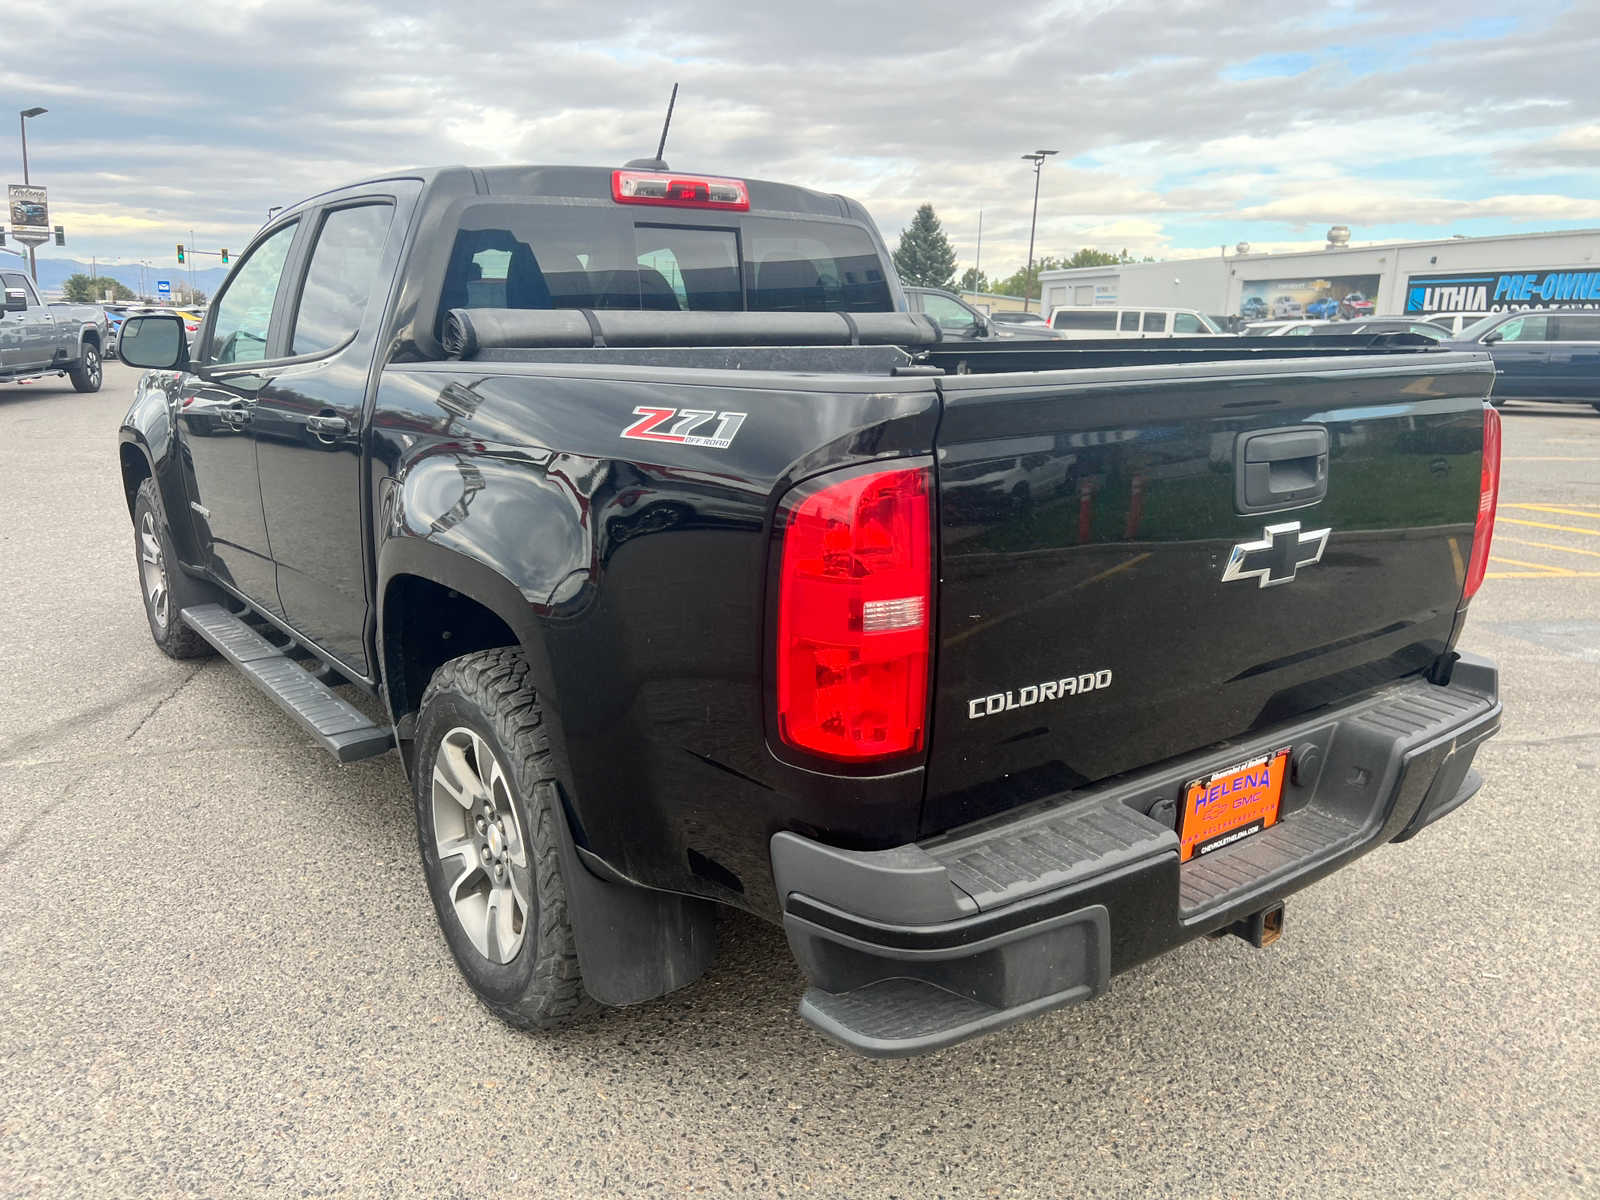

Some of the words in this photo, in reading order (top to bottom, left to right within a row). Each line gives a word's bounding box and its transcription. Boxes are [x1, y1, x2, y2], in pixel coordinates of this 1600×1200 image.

[1423, 286, 1487, 311] LITHIA
[620, 406, 747, 444] Z71
[703, 438, 729, 447] ROAD
[969, 669, 1112, 719] COLORADO
[1195, 769, 1270, 815] HELENA
[1233, 791, 1263, 809] GMC
